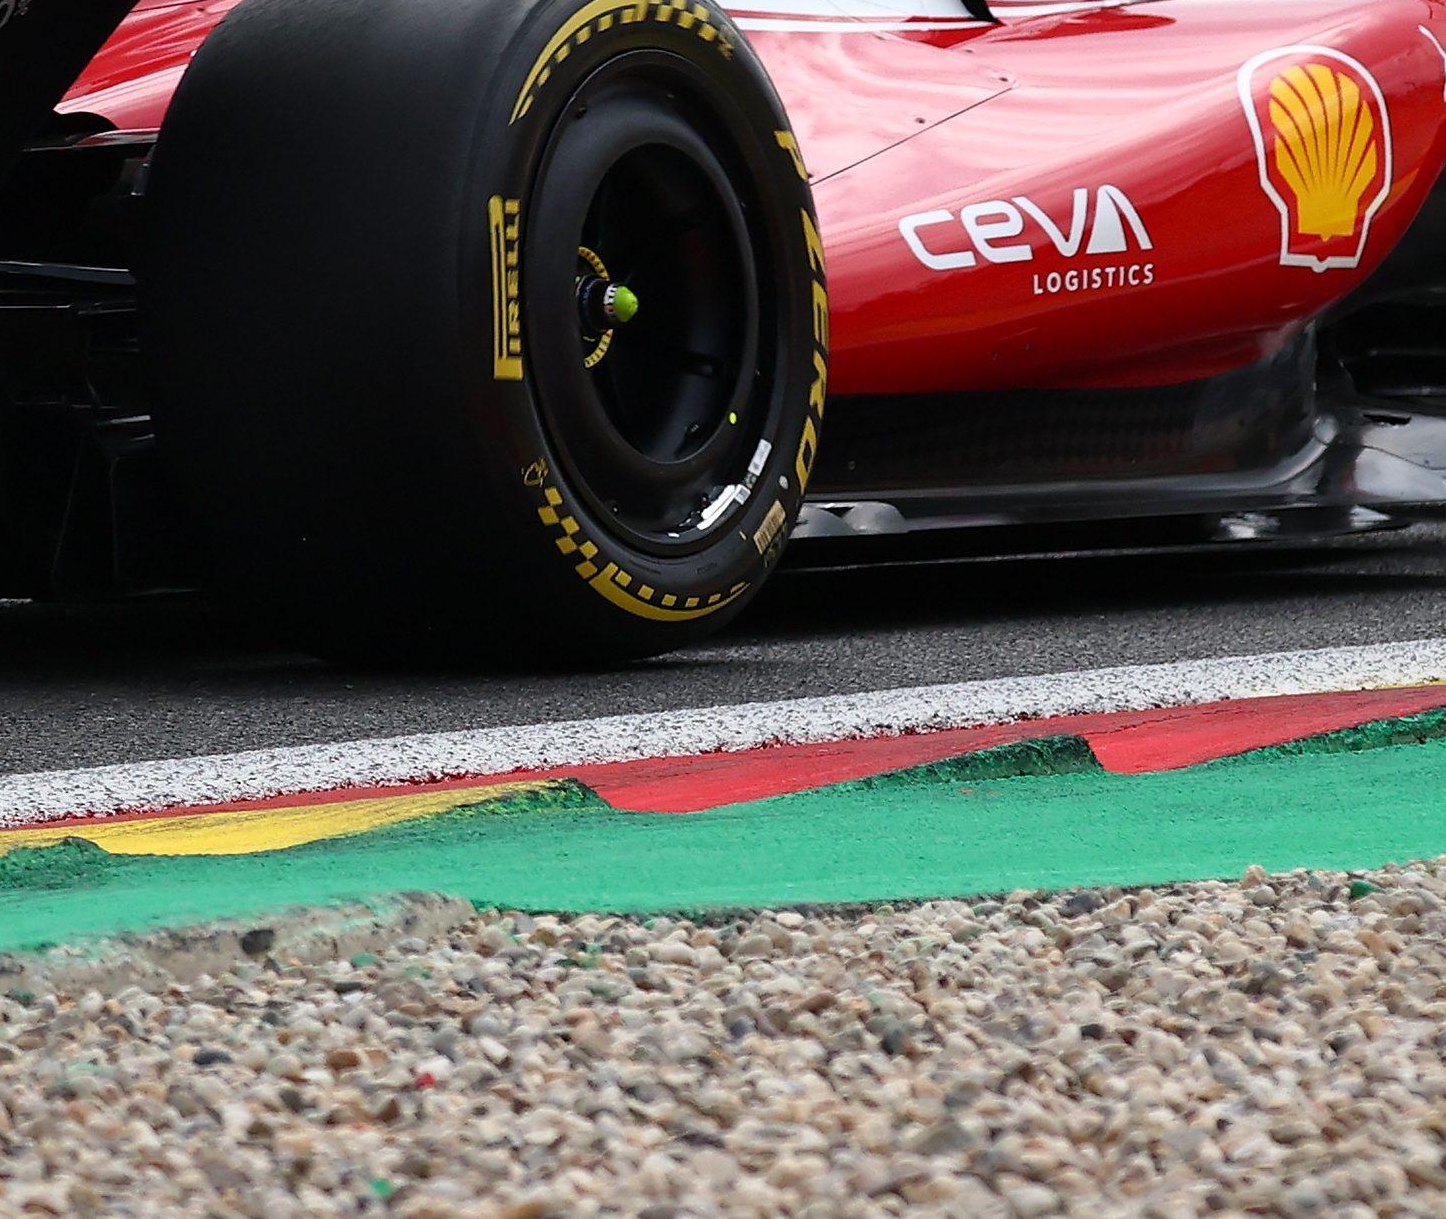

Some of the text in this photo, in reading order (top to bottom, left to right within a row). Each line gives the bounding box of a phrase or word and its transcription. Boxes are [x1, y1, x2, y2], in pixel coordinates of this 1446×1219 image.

[488, 194, 523, 380] PIRELLI
[796, 206, 829, 496] ZERO
[1033, 263, 1154, 295] LOGISTICS
